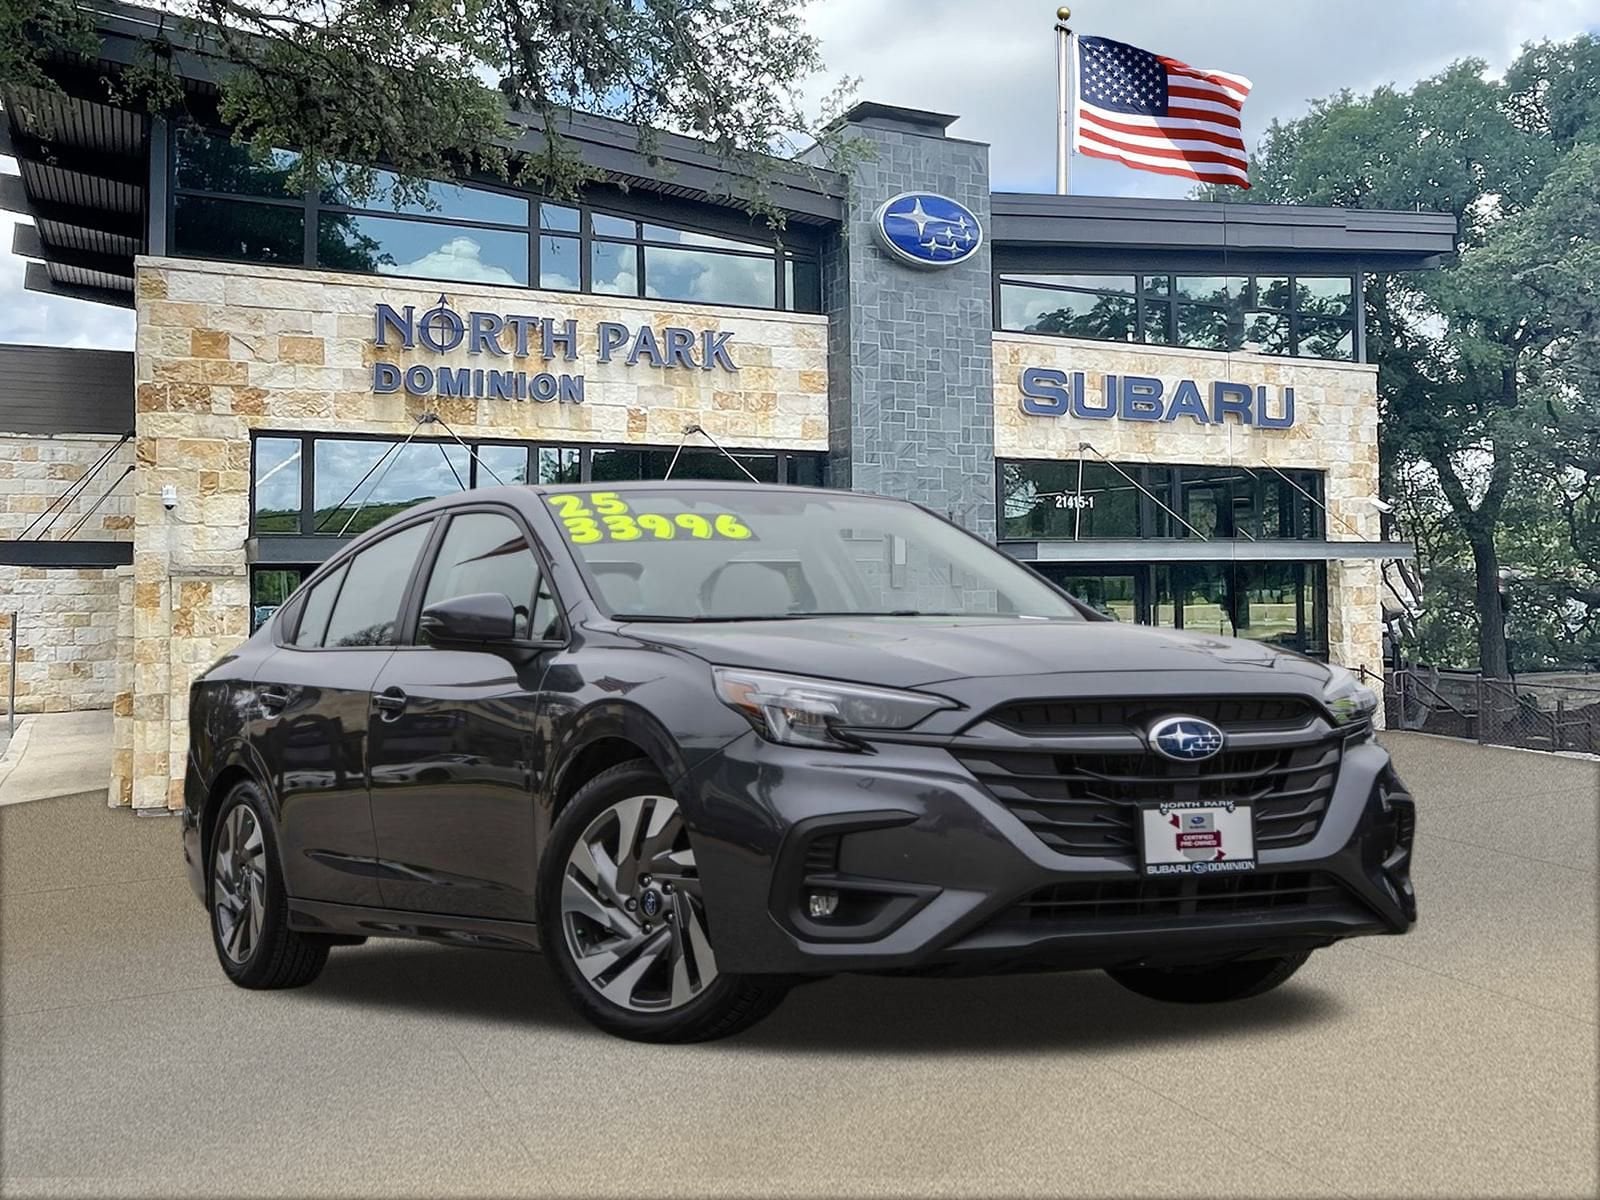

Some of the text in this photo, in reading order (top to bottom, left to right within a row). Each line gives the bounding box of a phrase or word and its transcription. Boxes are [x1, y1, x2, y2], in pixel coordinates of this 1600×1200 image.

[375, 295, 741, 373] NORTH PARK
[373, 362, 585, 404] DOMINION
[1018, 367, 1295, 430] SUBARU
[548, 491, 628, 519] 25
[563, 513, 753, 545] 33996
[1160, 800, 1234, 809] NORTH PARK
[1147, 861, 1255, 875] SUBARU DOMINION
